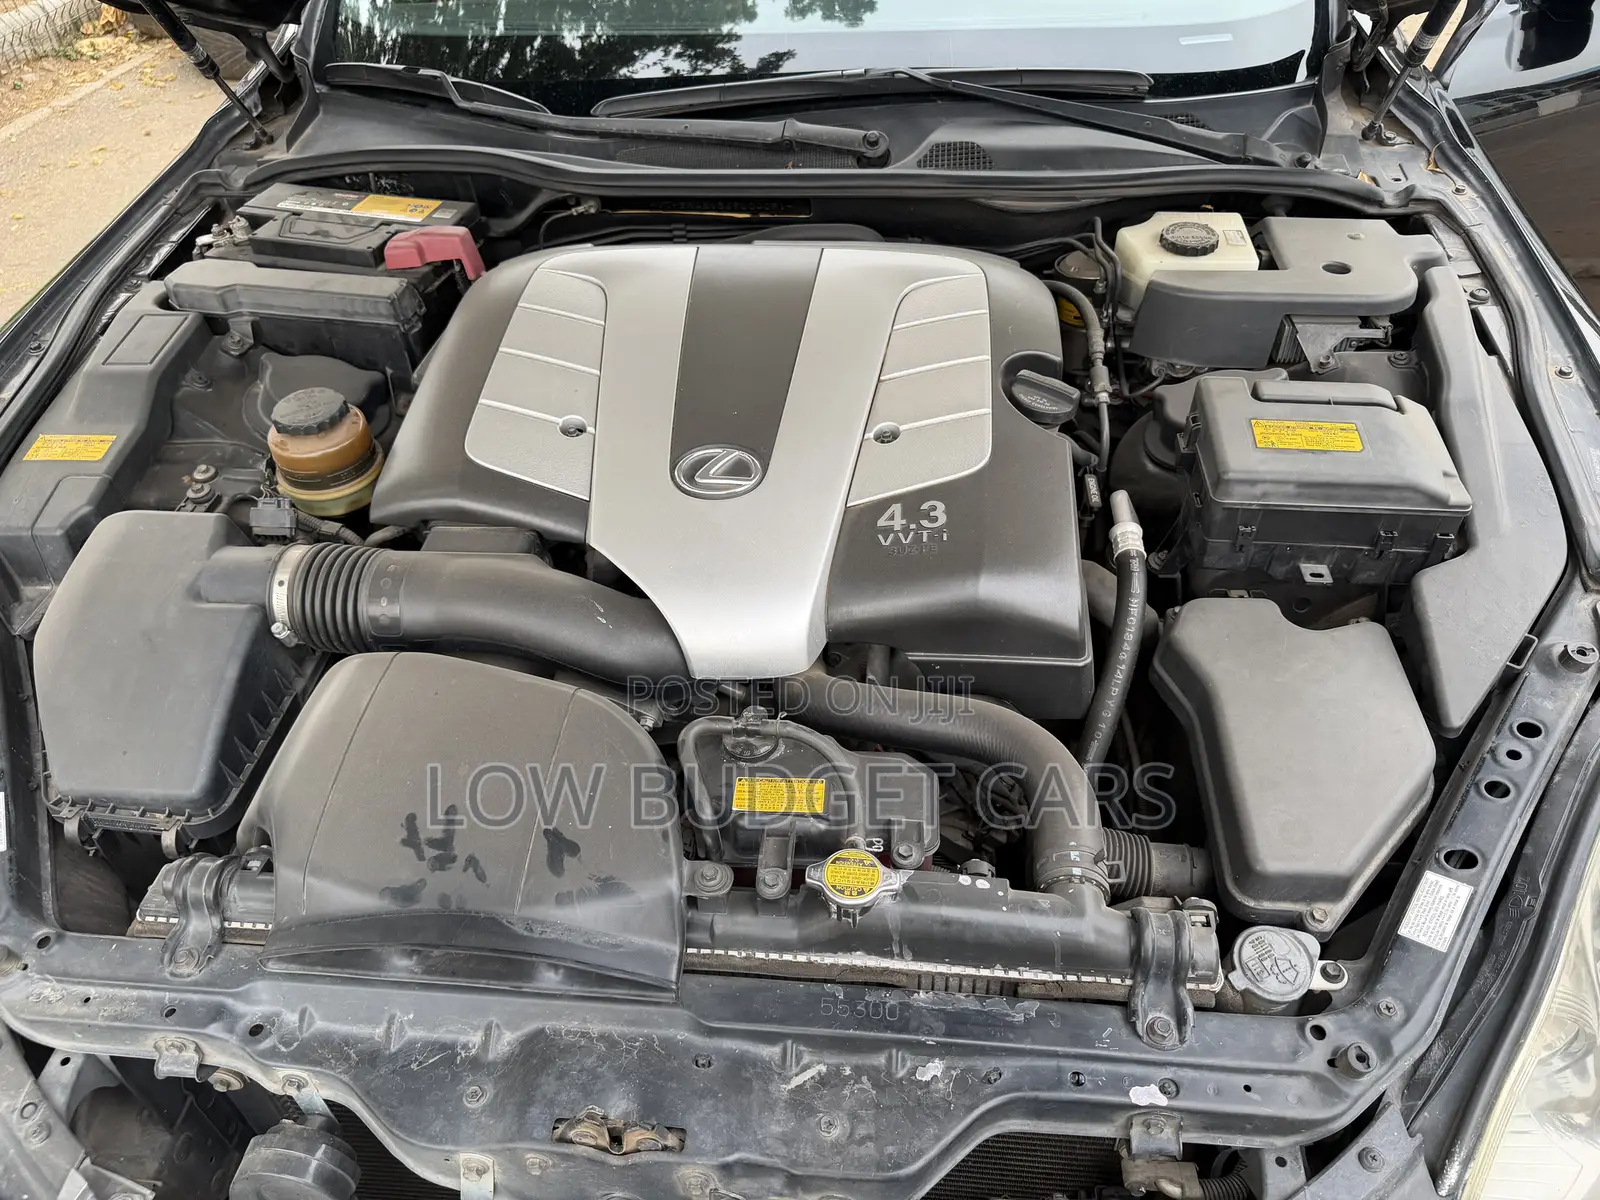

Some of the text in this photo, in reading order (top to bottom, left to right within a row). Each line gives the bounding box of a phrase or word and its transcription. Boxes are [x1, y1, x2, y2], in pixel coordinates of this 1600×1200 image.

[877, 500, 947, 531] 4.3
[877, 528, 948, 546] VVT-i
[820, 997, 899, 1020] 55300
